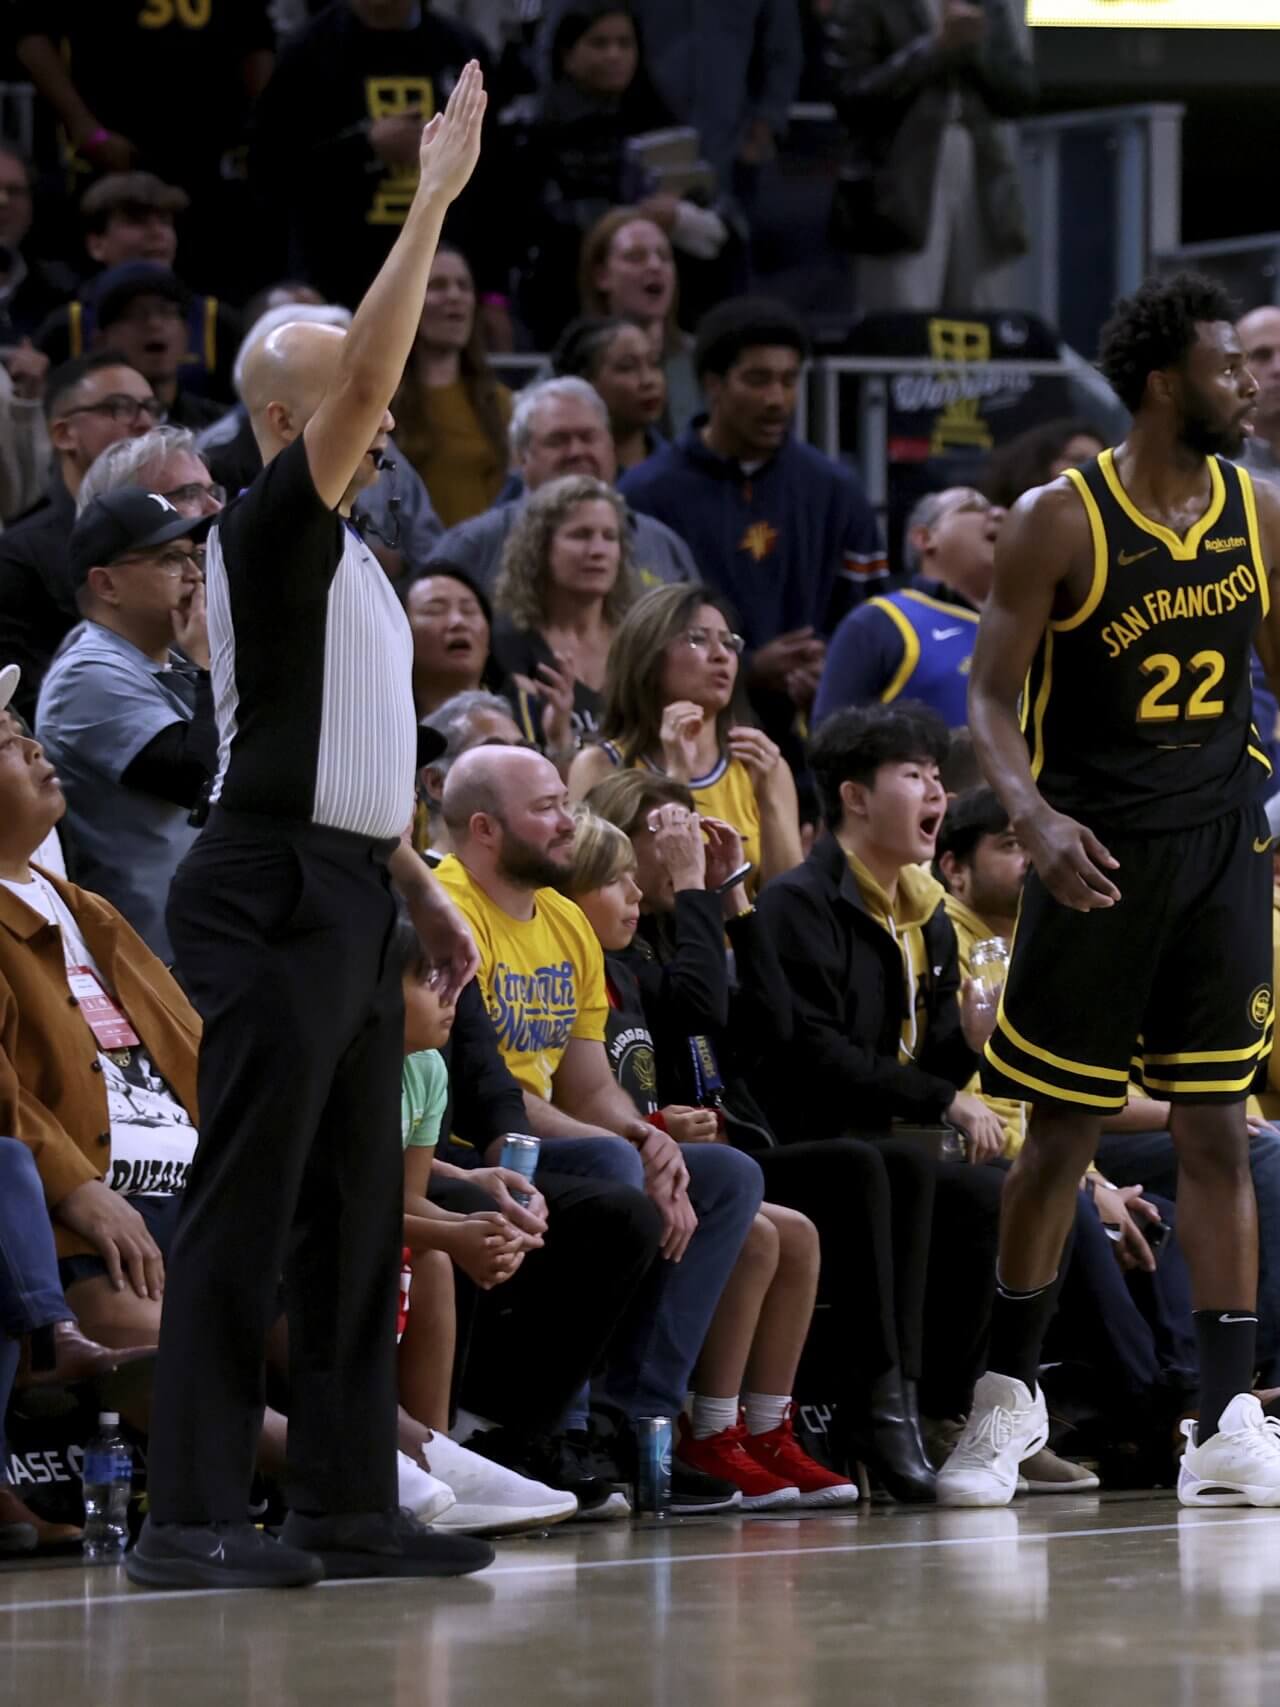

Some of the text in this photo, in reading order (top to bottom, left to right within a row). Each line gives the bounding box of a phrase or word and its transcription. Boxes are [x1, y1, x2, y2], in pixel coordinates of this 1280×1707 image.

[1204, 536, 1247, 553] Rakuten
[1102, 564, 1256, 658] SAN FRANCISCO
[1136, 649, 1225, 722] 22
[5, 1450, 71, 1485] ASE
